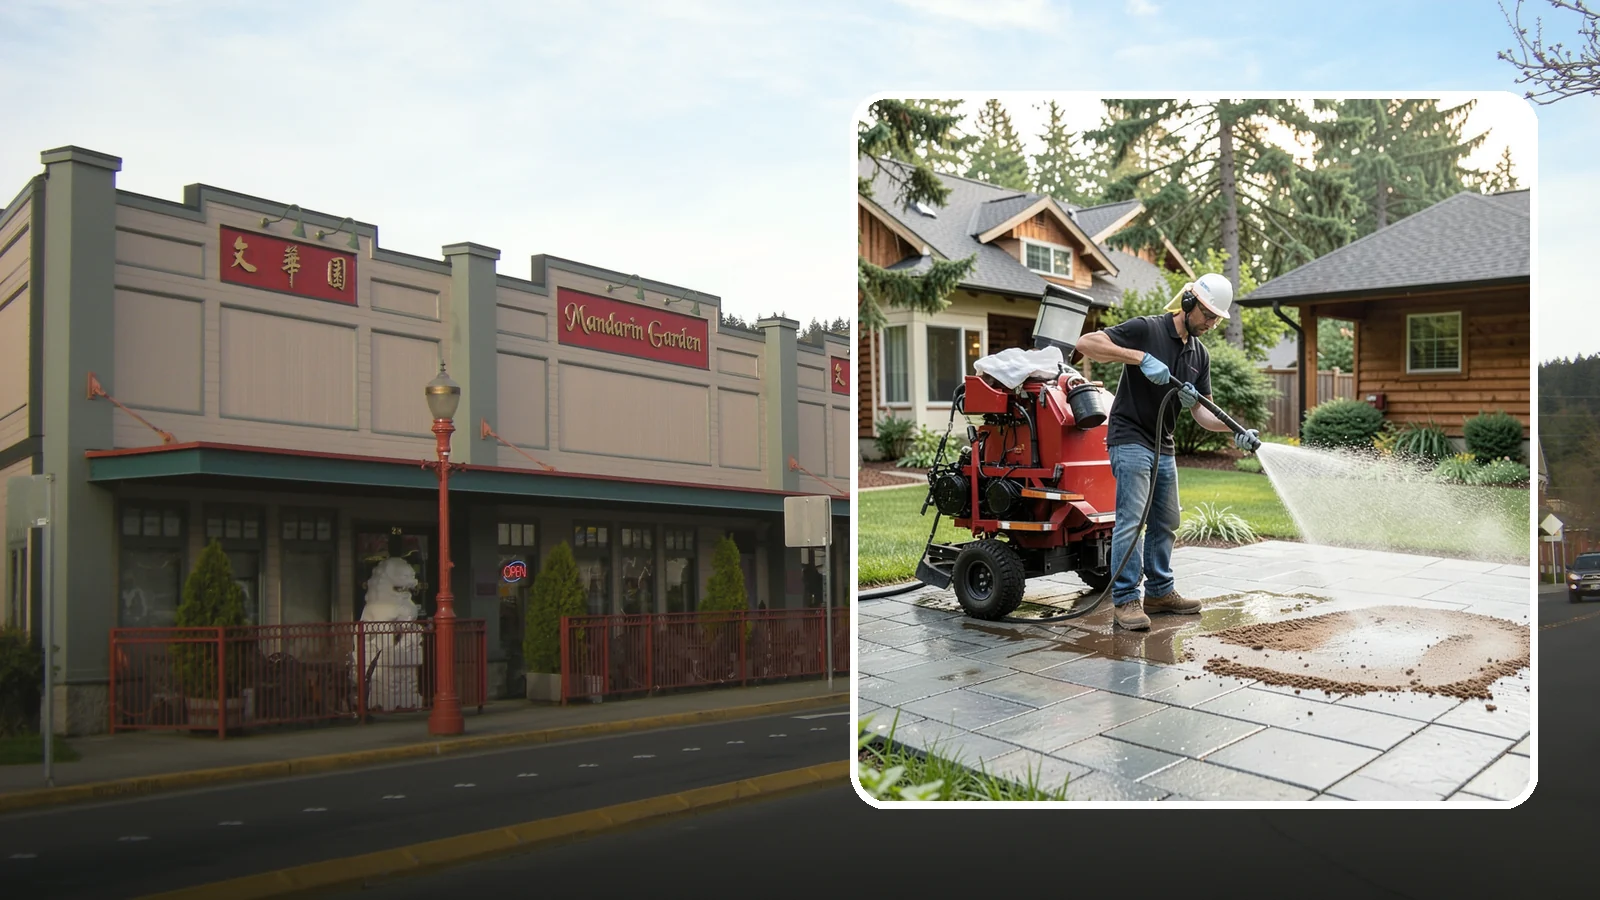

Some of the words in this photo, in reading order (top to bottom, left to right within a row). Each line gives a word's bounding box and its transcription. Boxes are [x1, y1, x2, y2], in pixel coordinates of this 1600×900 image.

[230, 235, 346, 291] 文華園
[564, 302, 644, 341] Mandarin
[647, 320, 702, 352] Garden
[503, 565, 527, 578] OPEN
